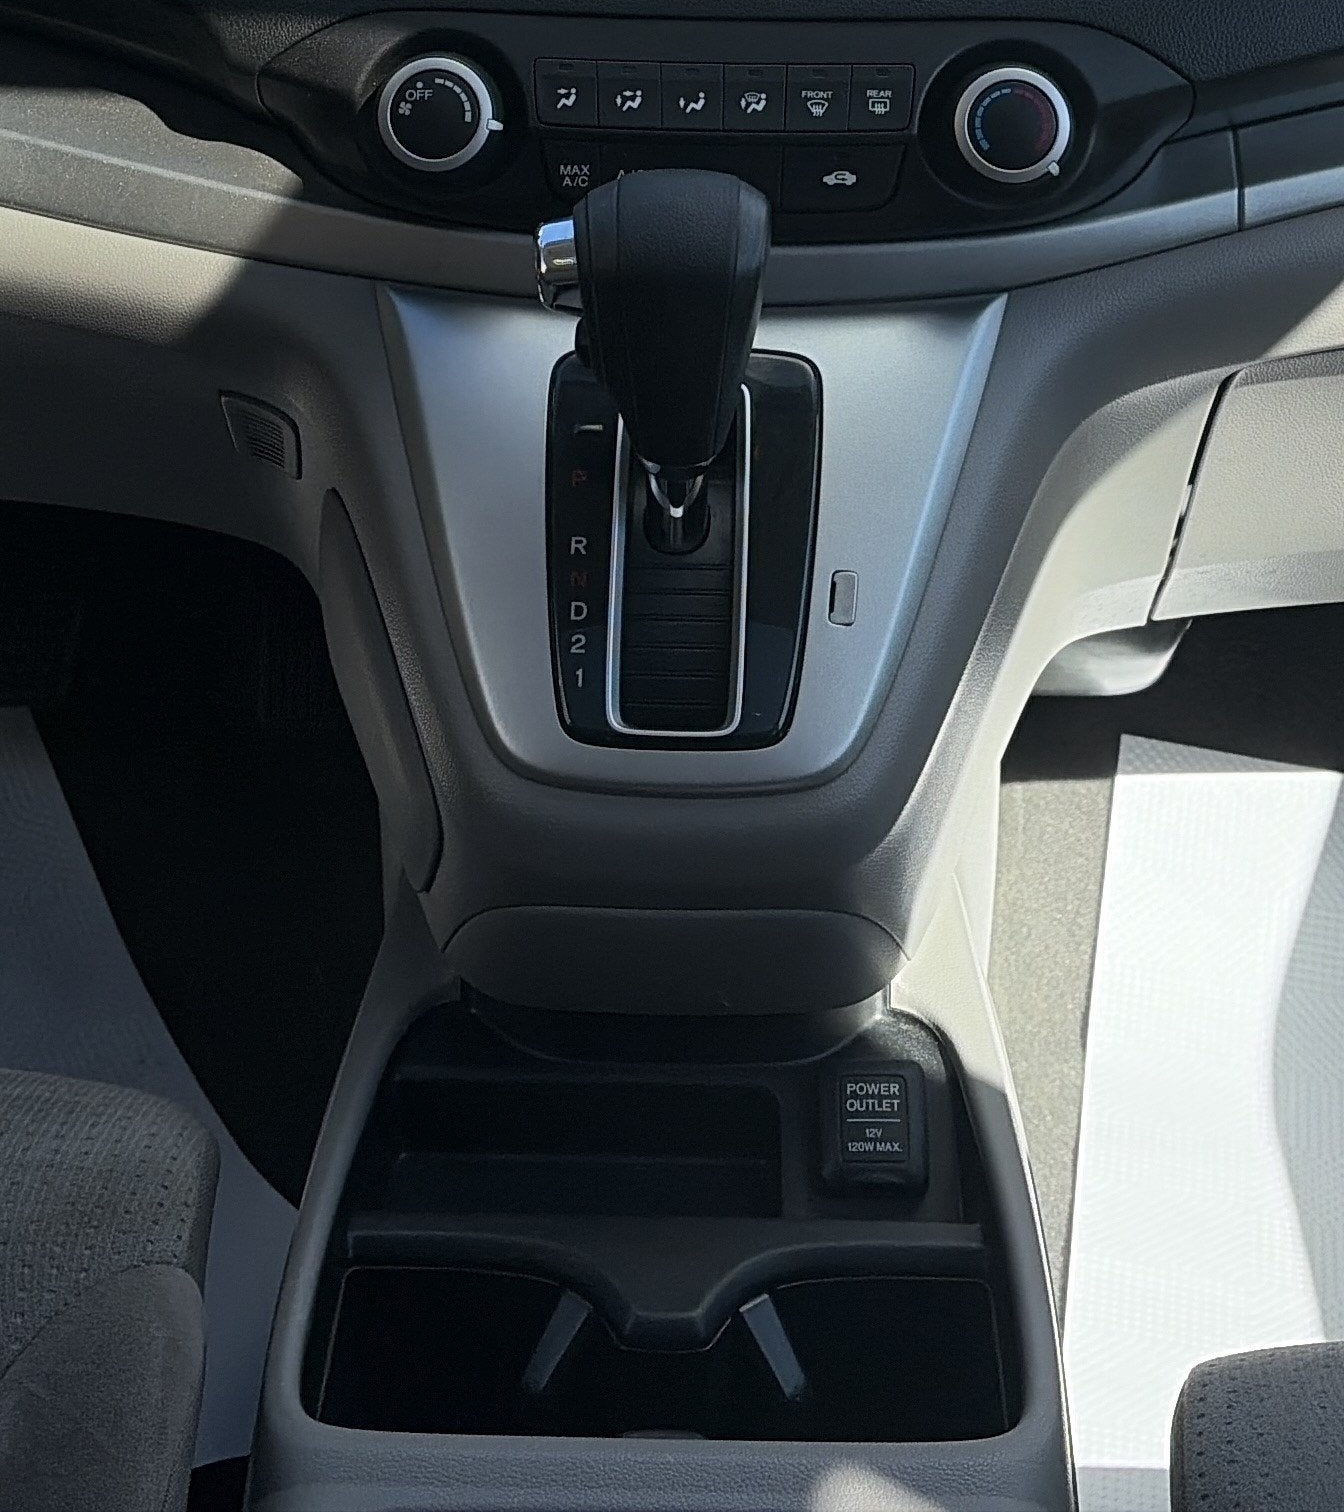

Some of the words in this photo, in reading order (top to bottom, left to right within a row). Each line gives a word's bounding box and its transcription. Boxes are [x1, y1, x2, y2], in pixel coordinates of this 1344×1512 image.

[405, 89, 433, 101] OFF
[801, 90, 834, 100] FRONT
[866, 89, 892, 99] REAR
[559, 164, 590, 176] MAX
[562, 176, 589, 188] A/C
[570, 536, 587, 555] R
[570, 601, 588, 621] D
[570, 634, 587, 654] 2
[574, 668, 584, 688] 1
[846, 1082, 900, 1096] POWER
[845, 1098, 901, 1112] OUTLET
[865, 1128, 883, 1138] 12V
[847, 1141, 874, 1152] 120W
